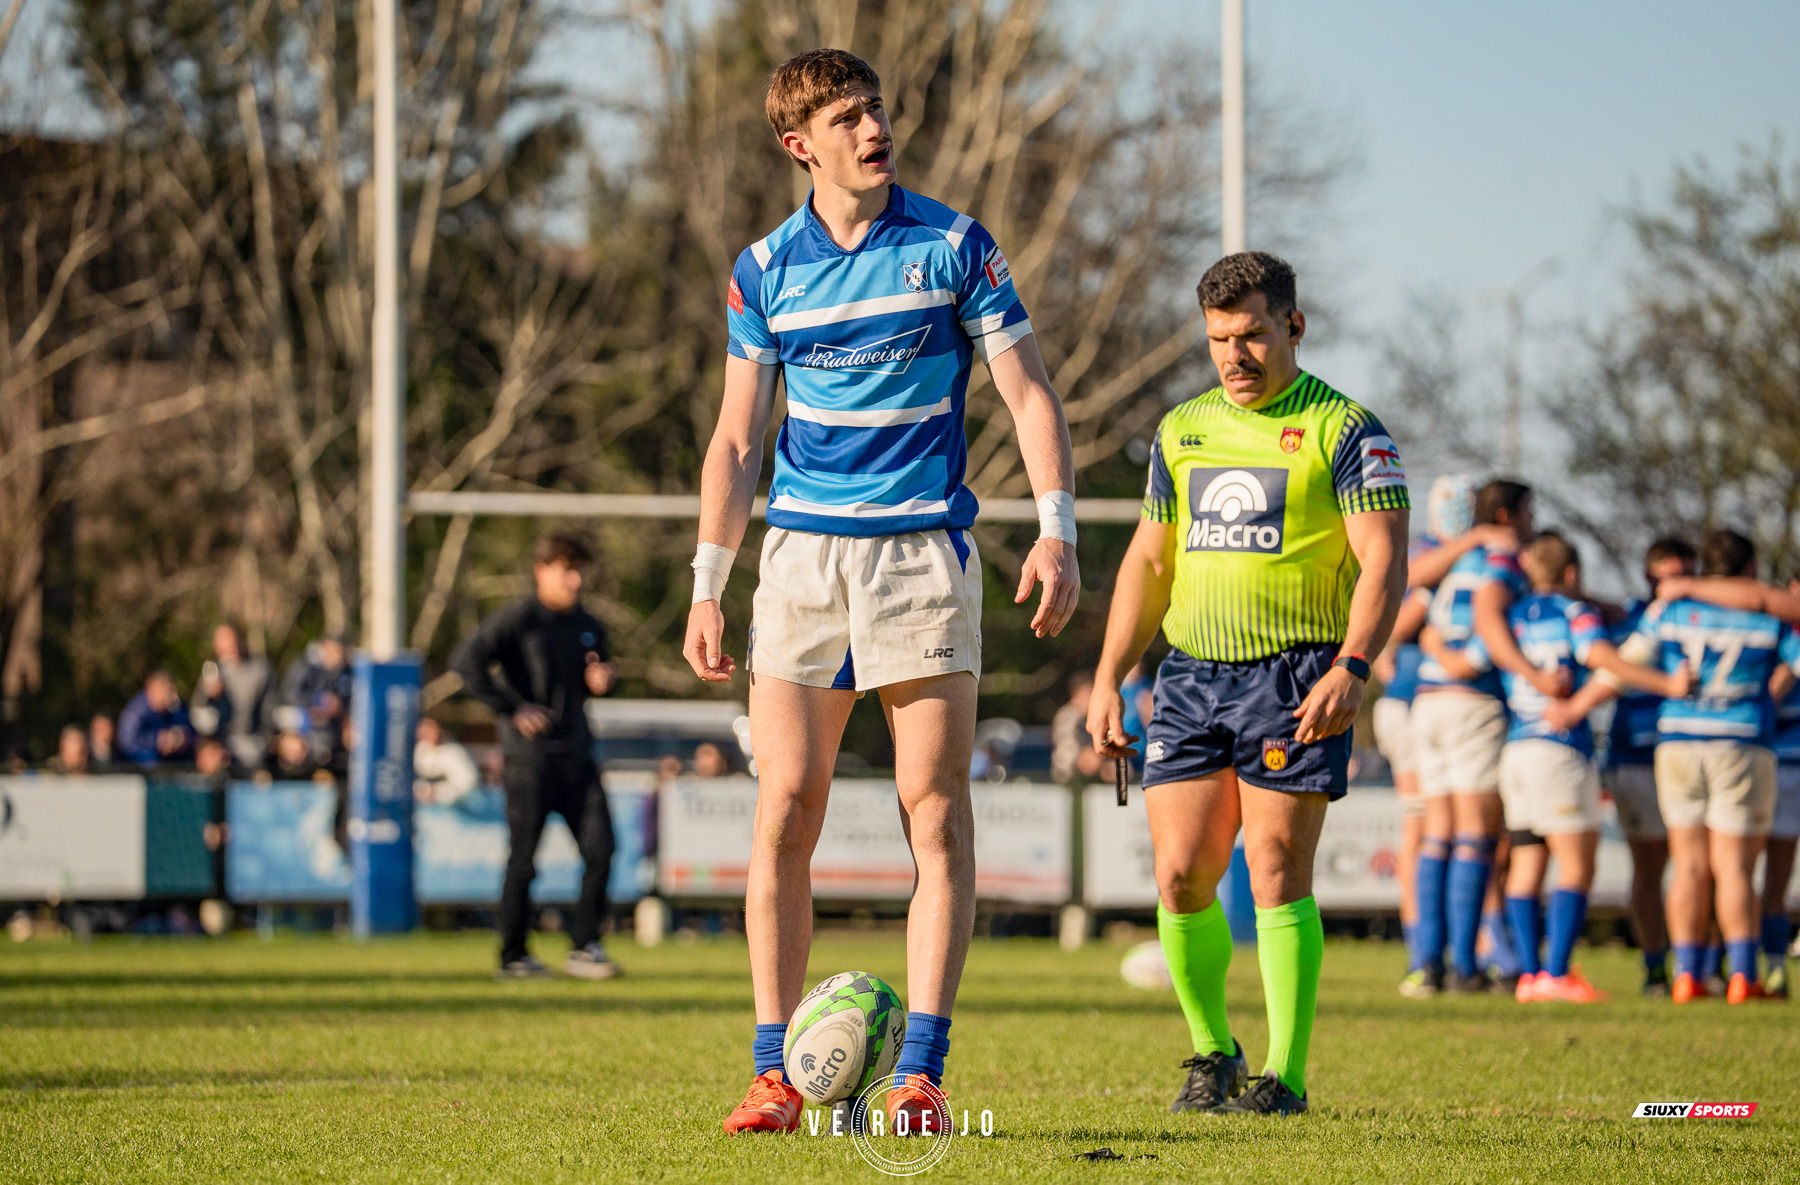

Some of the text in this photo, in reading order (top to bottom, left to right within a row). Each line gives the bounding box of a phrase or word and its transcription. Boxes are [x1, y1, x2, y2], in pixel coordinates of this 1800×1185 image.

[778, 284, 806, 300] LRC
[805, 345, 917, 369] Budweiser
[1186, 518, 1280, 550] Macro
[924, 647, 954, 659] LRC
[805, 1047, 847, 1099] Macro
